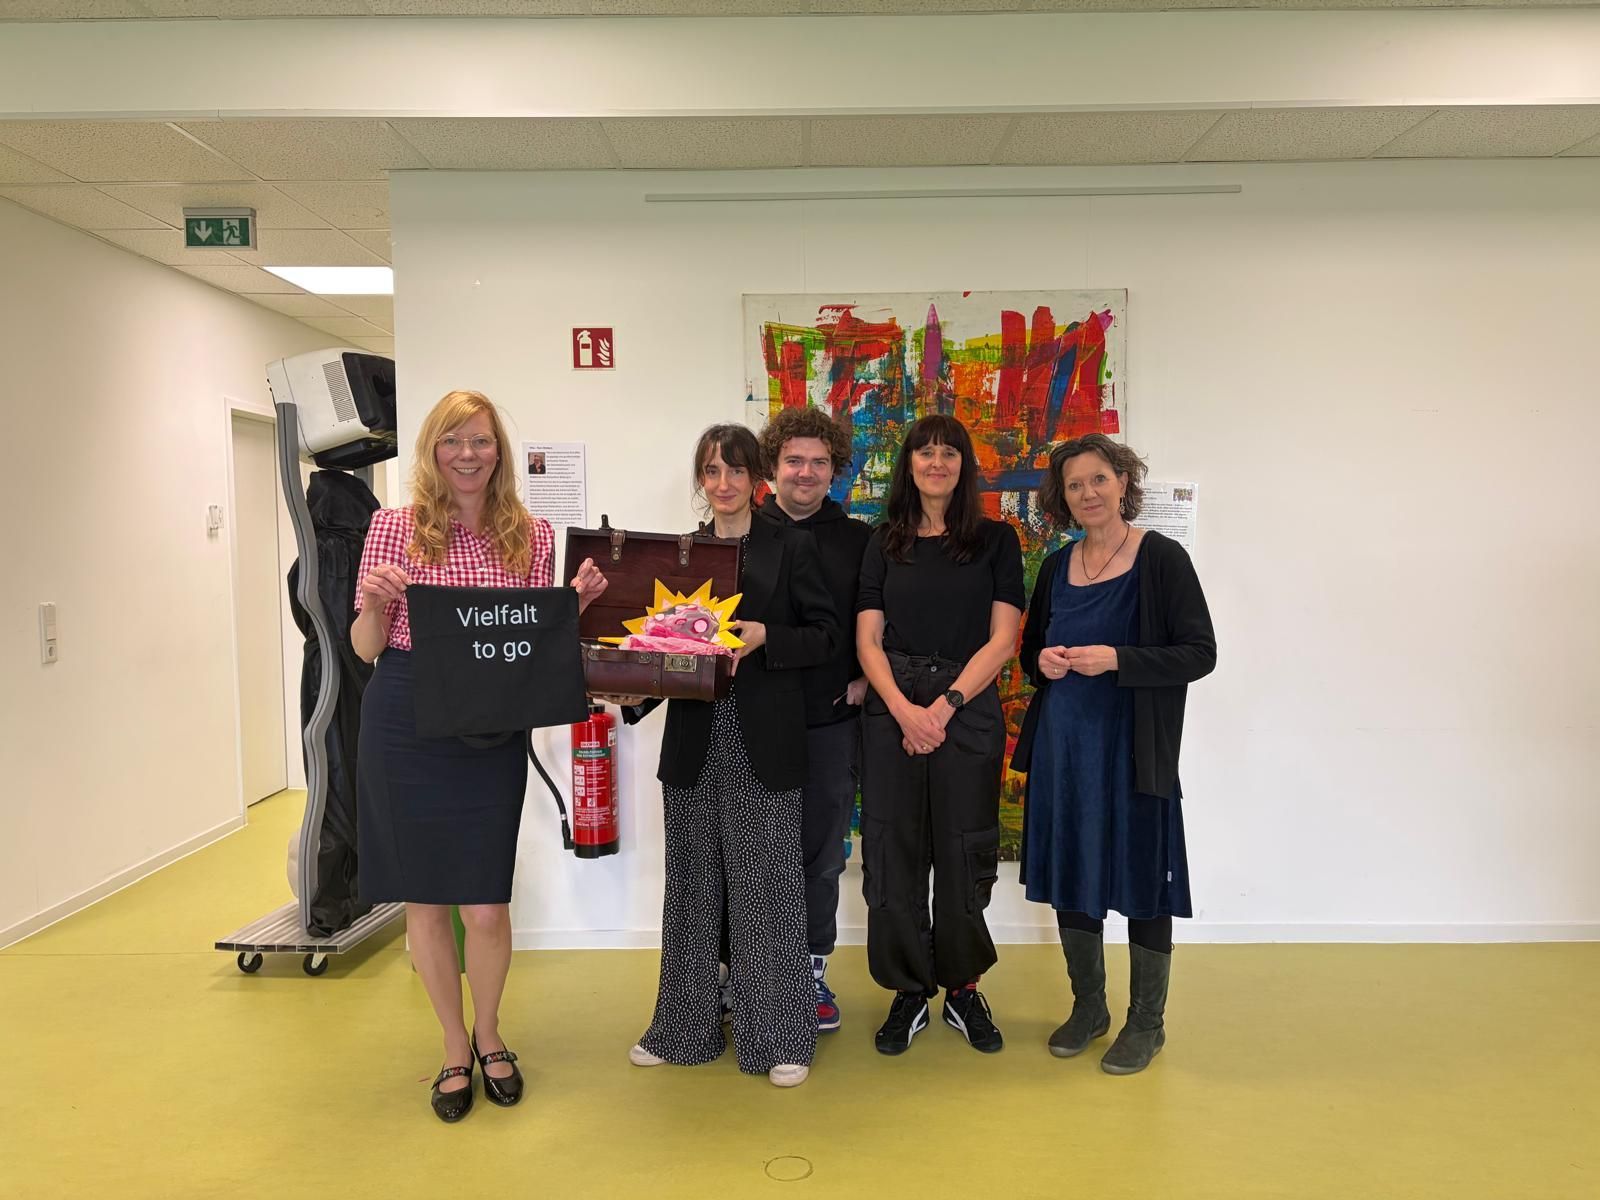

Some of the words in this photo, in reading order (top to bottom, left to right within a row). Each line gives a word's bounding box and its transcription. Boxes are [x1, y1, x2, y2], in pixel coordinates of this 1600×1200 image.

[456, 603, 538, 627] Vielfalt
[472, 641, 496, 659] to
[503, 641, 531, 662] go
